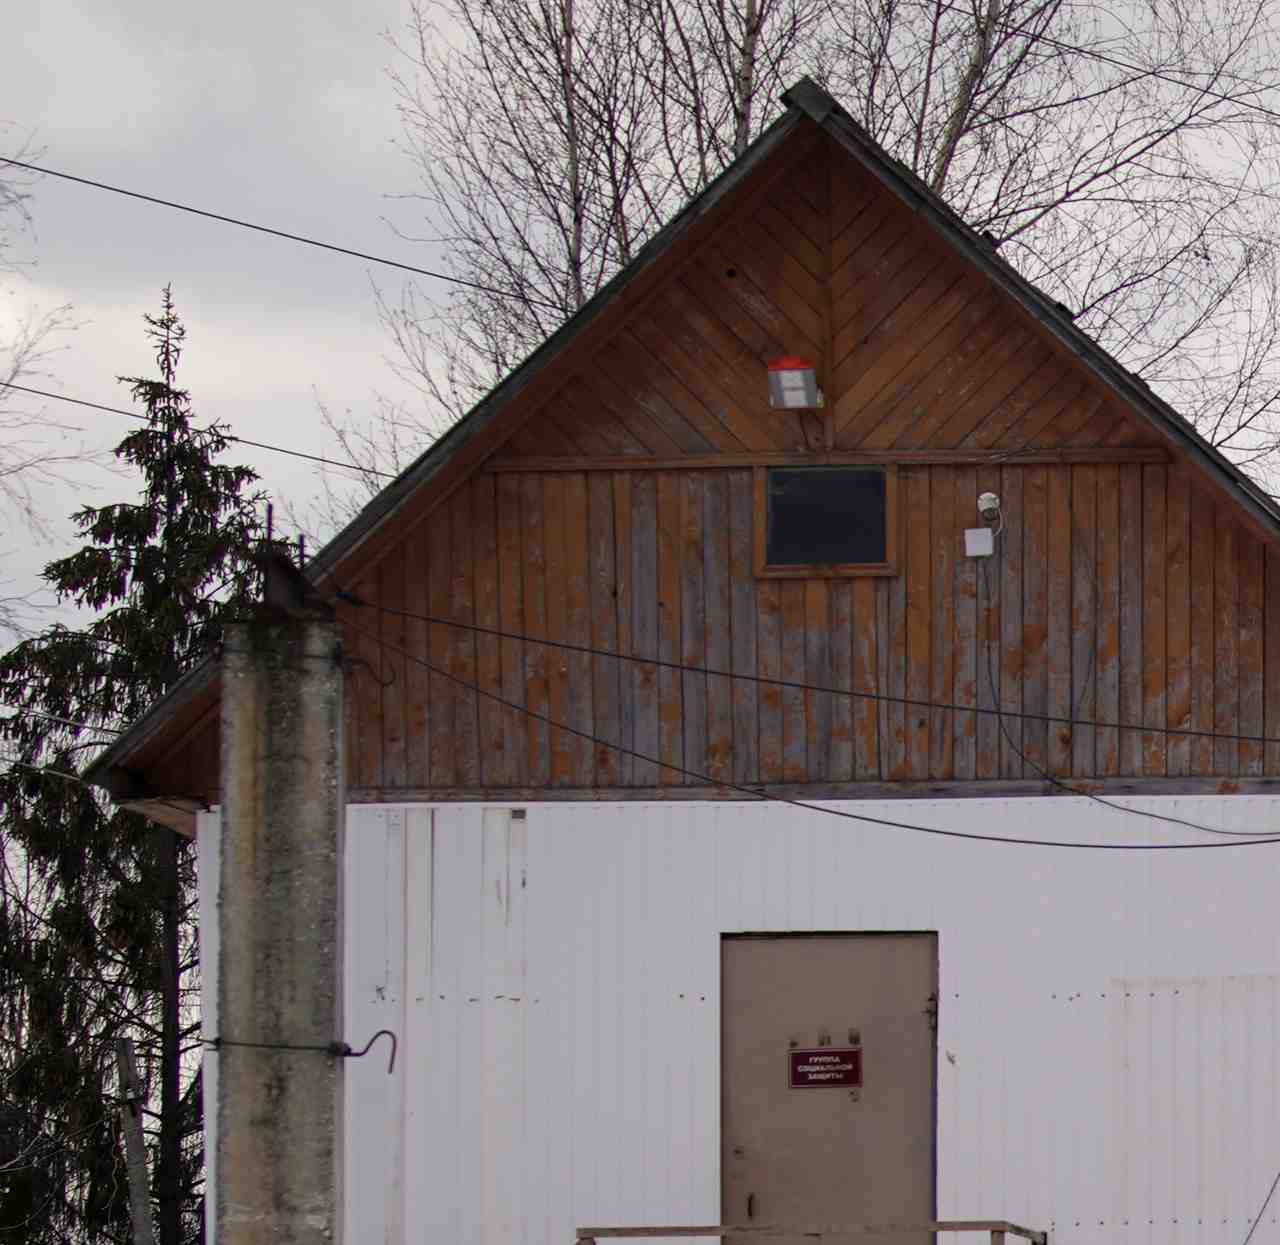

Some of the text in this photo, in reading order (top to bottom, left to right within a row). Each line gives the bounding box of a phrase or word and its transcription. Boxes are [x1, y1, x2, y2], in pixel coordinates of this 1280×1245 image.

[808, 1055, 841, 1063] ГРУППА
[797, 1064, 853, 1073] СОЦИАЛЬНОЙ
[807, 1073, 844, 1081] ЗАЩИТЫ
